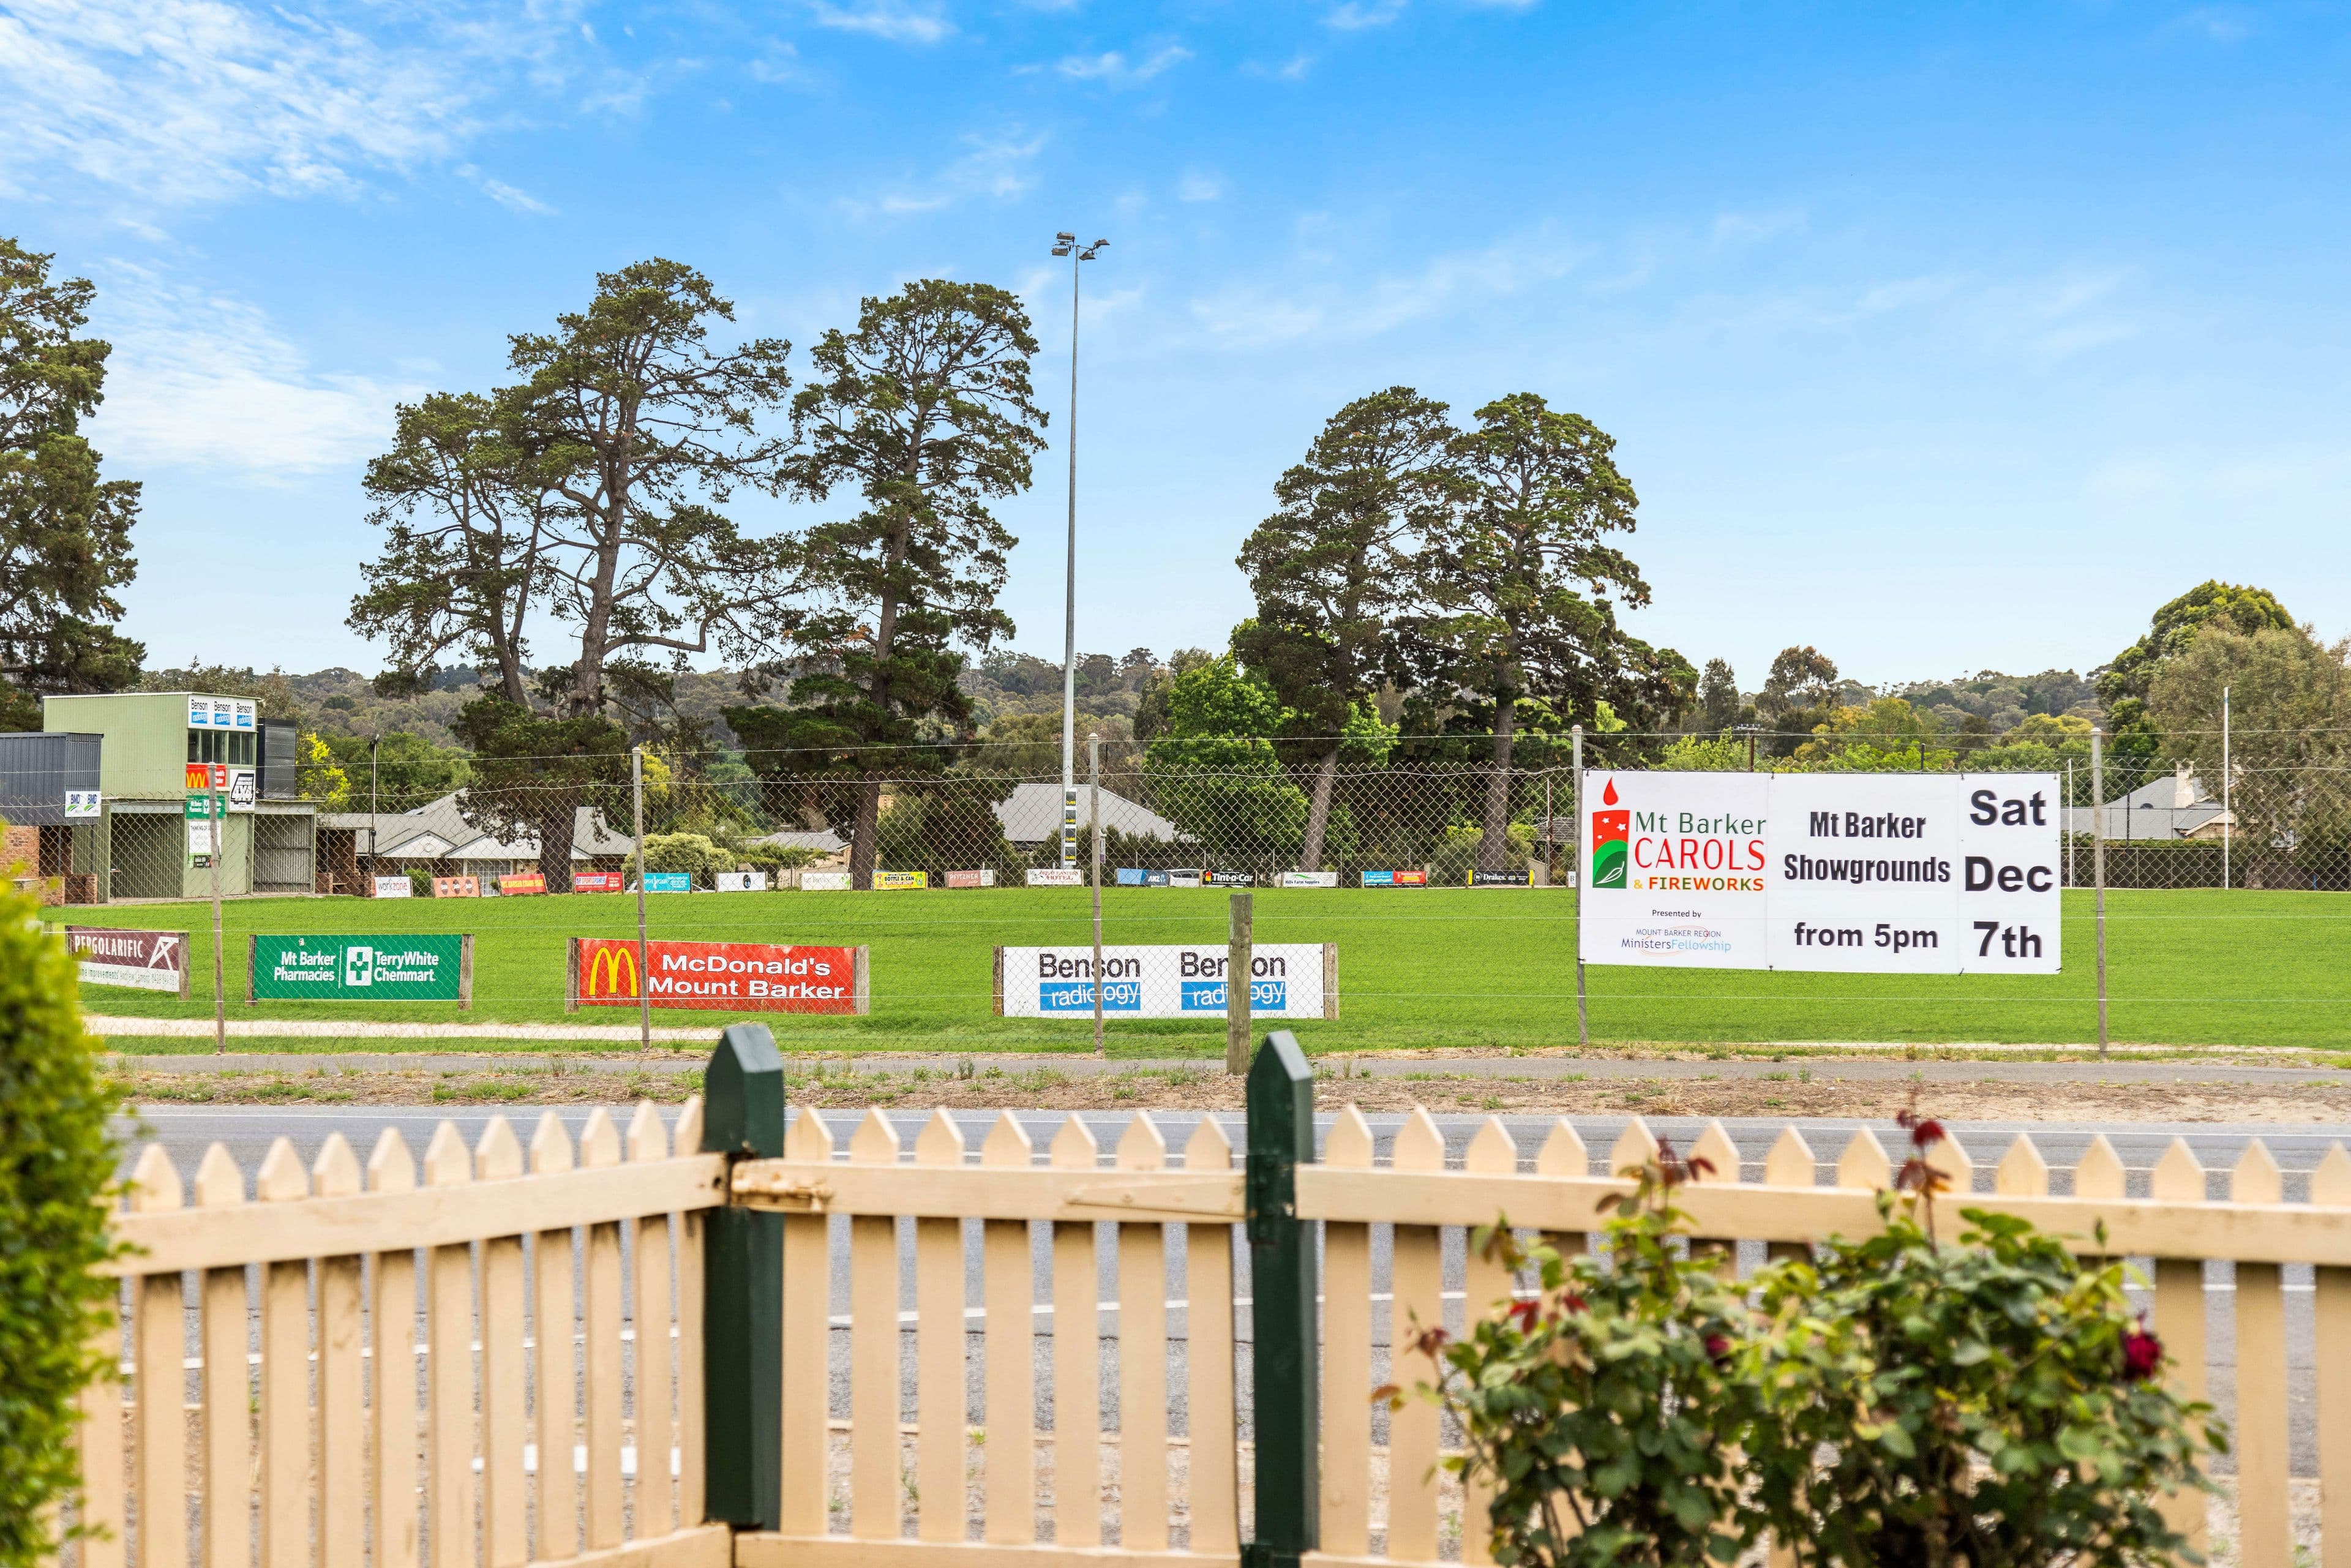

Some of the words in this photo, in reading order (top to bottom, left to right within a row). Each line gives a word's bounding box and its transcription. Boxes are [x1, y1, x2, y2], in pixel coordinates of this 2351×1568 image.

[191, 699, 208, 710] Benson
[214, 701, 230, 712] Benson
[237, 703, 252, 714] Benson
[1970, 790, 2047, 826] Sat
[1636, 812, 1667, 833] Mt
[1679, 812, 1766, 835] Barker
[1810, 812, 1839, 837] Mt
[1845, 812, 1926, 838] Barker
[1635, 838, 1765, 871] CAROLS
[1784, 854, 1951, 884] Showgrounds
[1965, 856, 2053, 892] Dec
[1633, 879, 1643, 889] &
[1649, 877, 1764, 891] FIREWORKS
[74, 935, 144, 959] PERGOLARIFIC
[1621, 937, 1731, 954] MinistersFellowship
[1794, 922, 1863, 947] from
[1874, 924, 1939, 953] 5pm
[1973, 921, 2042, 958] 7th
[281, 951, 297, 966] Mt
[299, 950, 336, 966] Barker
[375, 951, 440, 970] TerryWhite
[662, 955, 831, 976] McDonald's
[1180, 951, 1286, 977] Benon
[274, 966, 335, 981] Pharmacies
[649, 977, 738, 996] Mount
[749, 980, 844, 999] Barker
[1051, 983, 1139, 1007] radioogy
[1193, 982, 1284, 1006] radiogy
